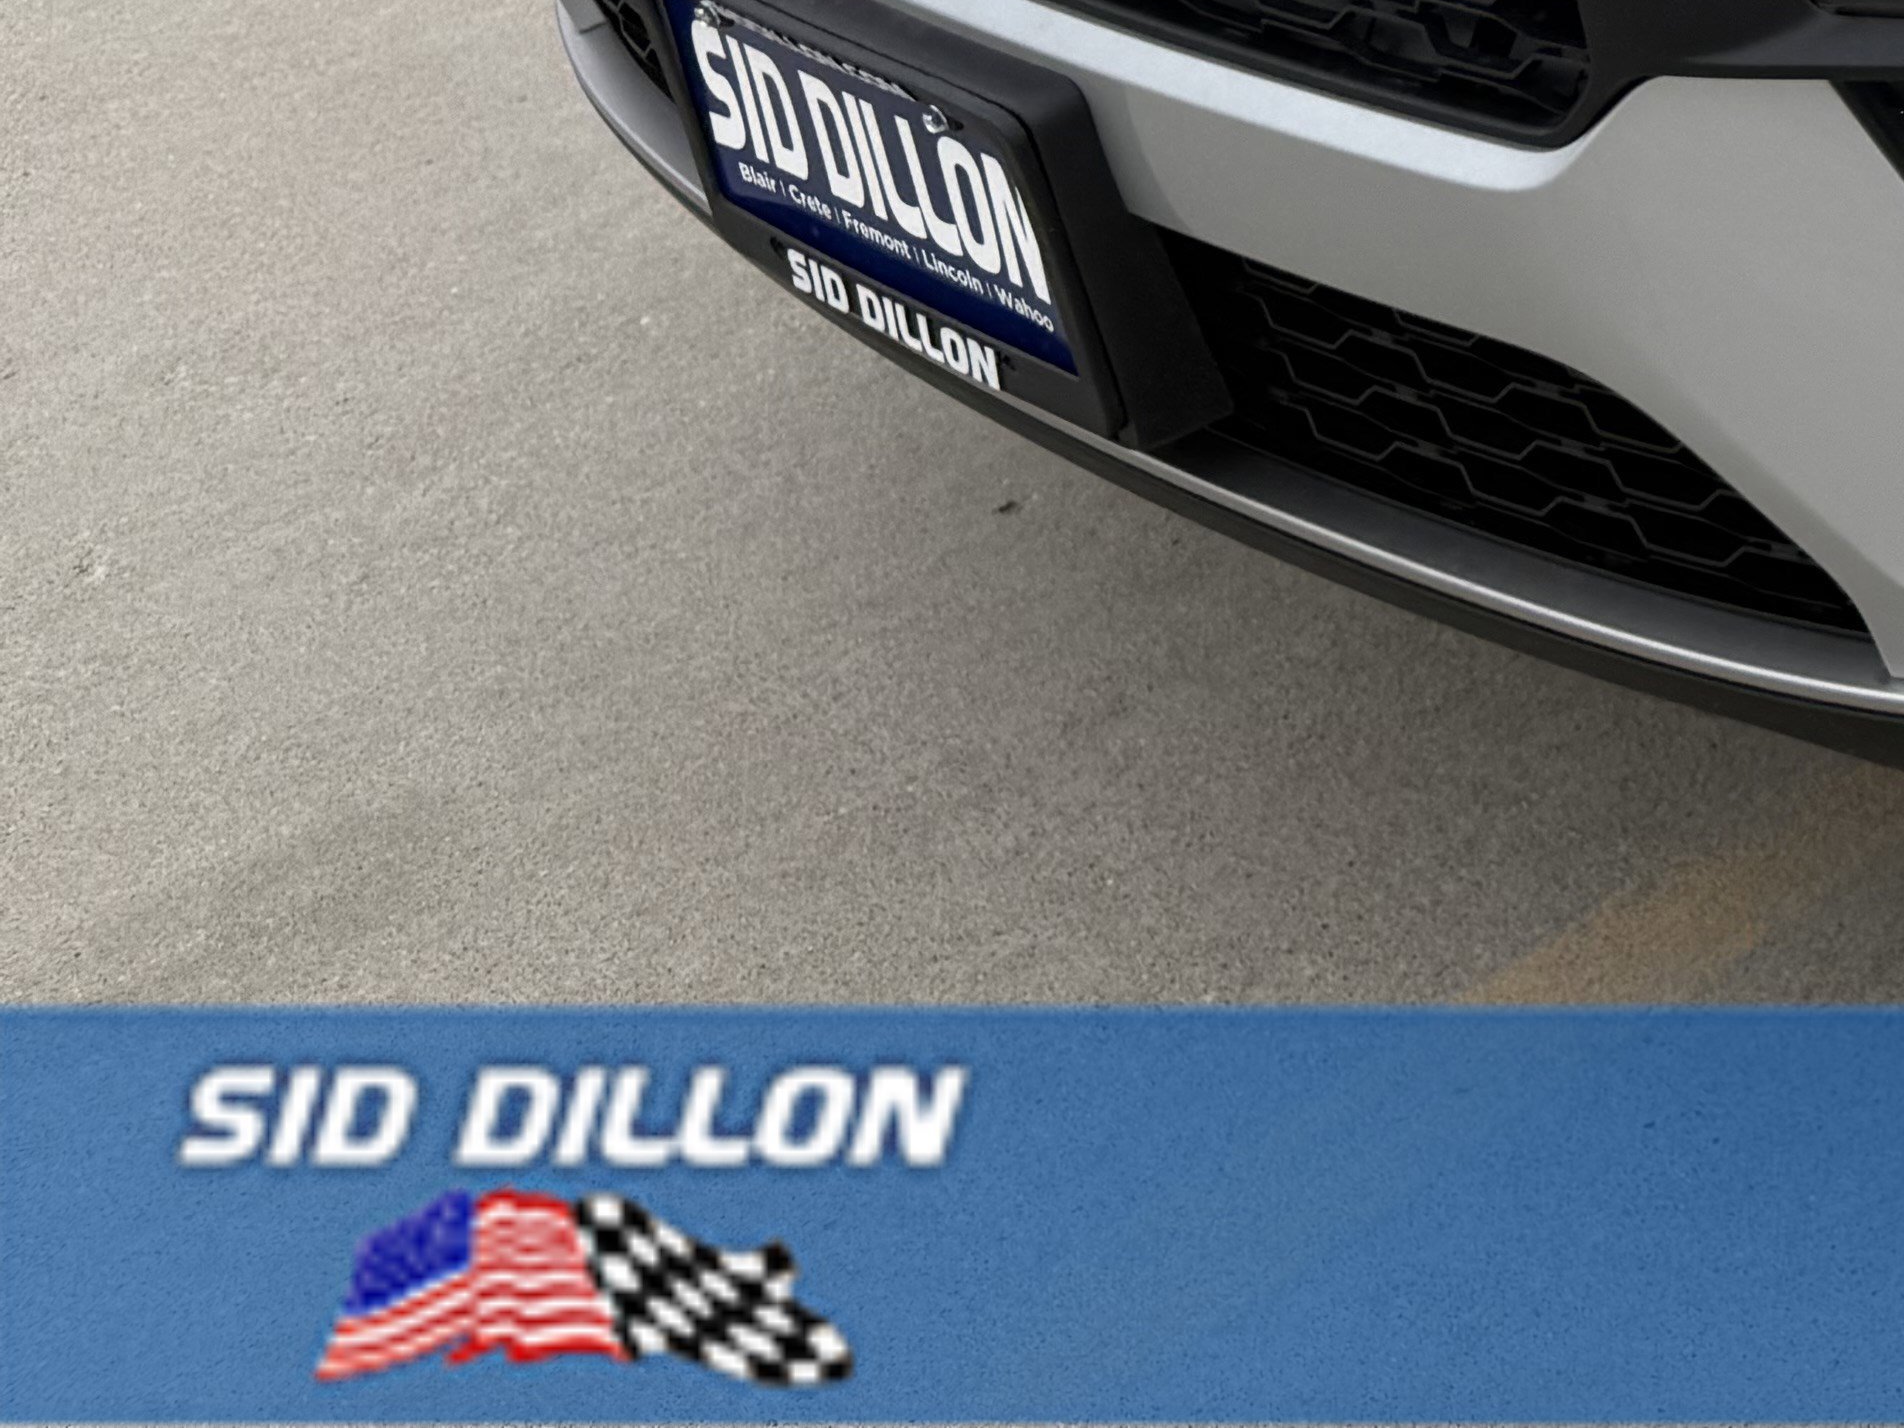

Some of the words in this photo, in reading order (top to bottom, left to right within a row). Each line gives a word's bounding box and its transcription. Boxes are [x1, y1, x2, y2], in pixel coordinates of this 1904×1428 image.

[691, 18, 809, 181] SID
[798, 67, 1052, 305] DILLON
[740, 161, 777, 195] Blair
[788, 184, 832, 222] Crete
[842, 208, 912, 262] Fremont
[924, 245, 984, 297] Lincoln
[996, 284, 1055, 335] Wahoo
[786, 247, 850, 314] SID
[857, 287, 1002, 392] DILLON
